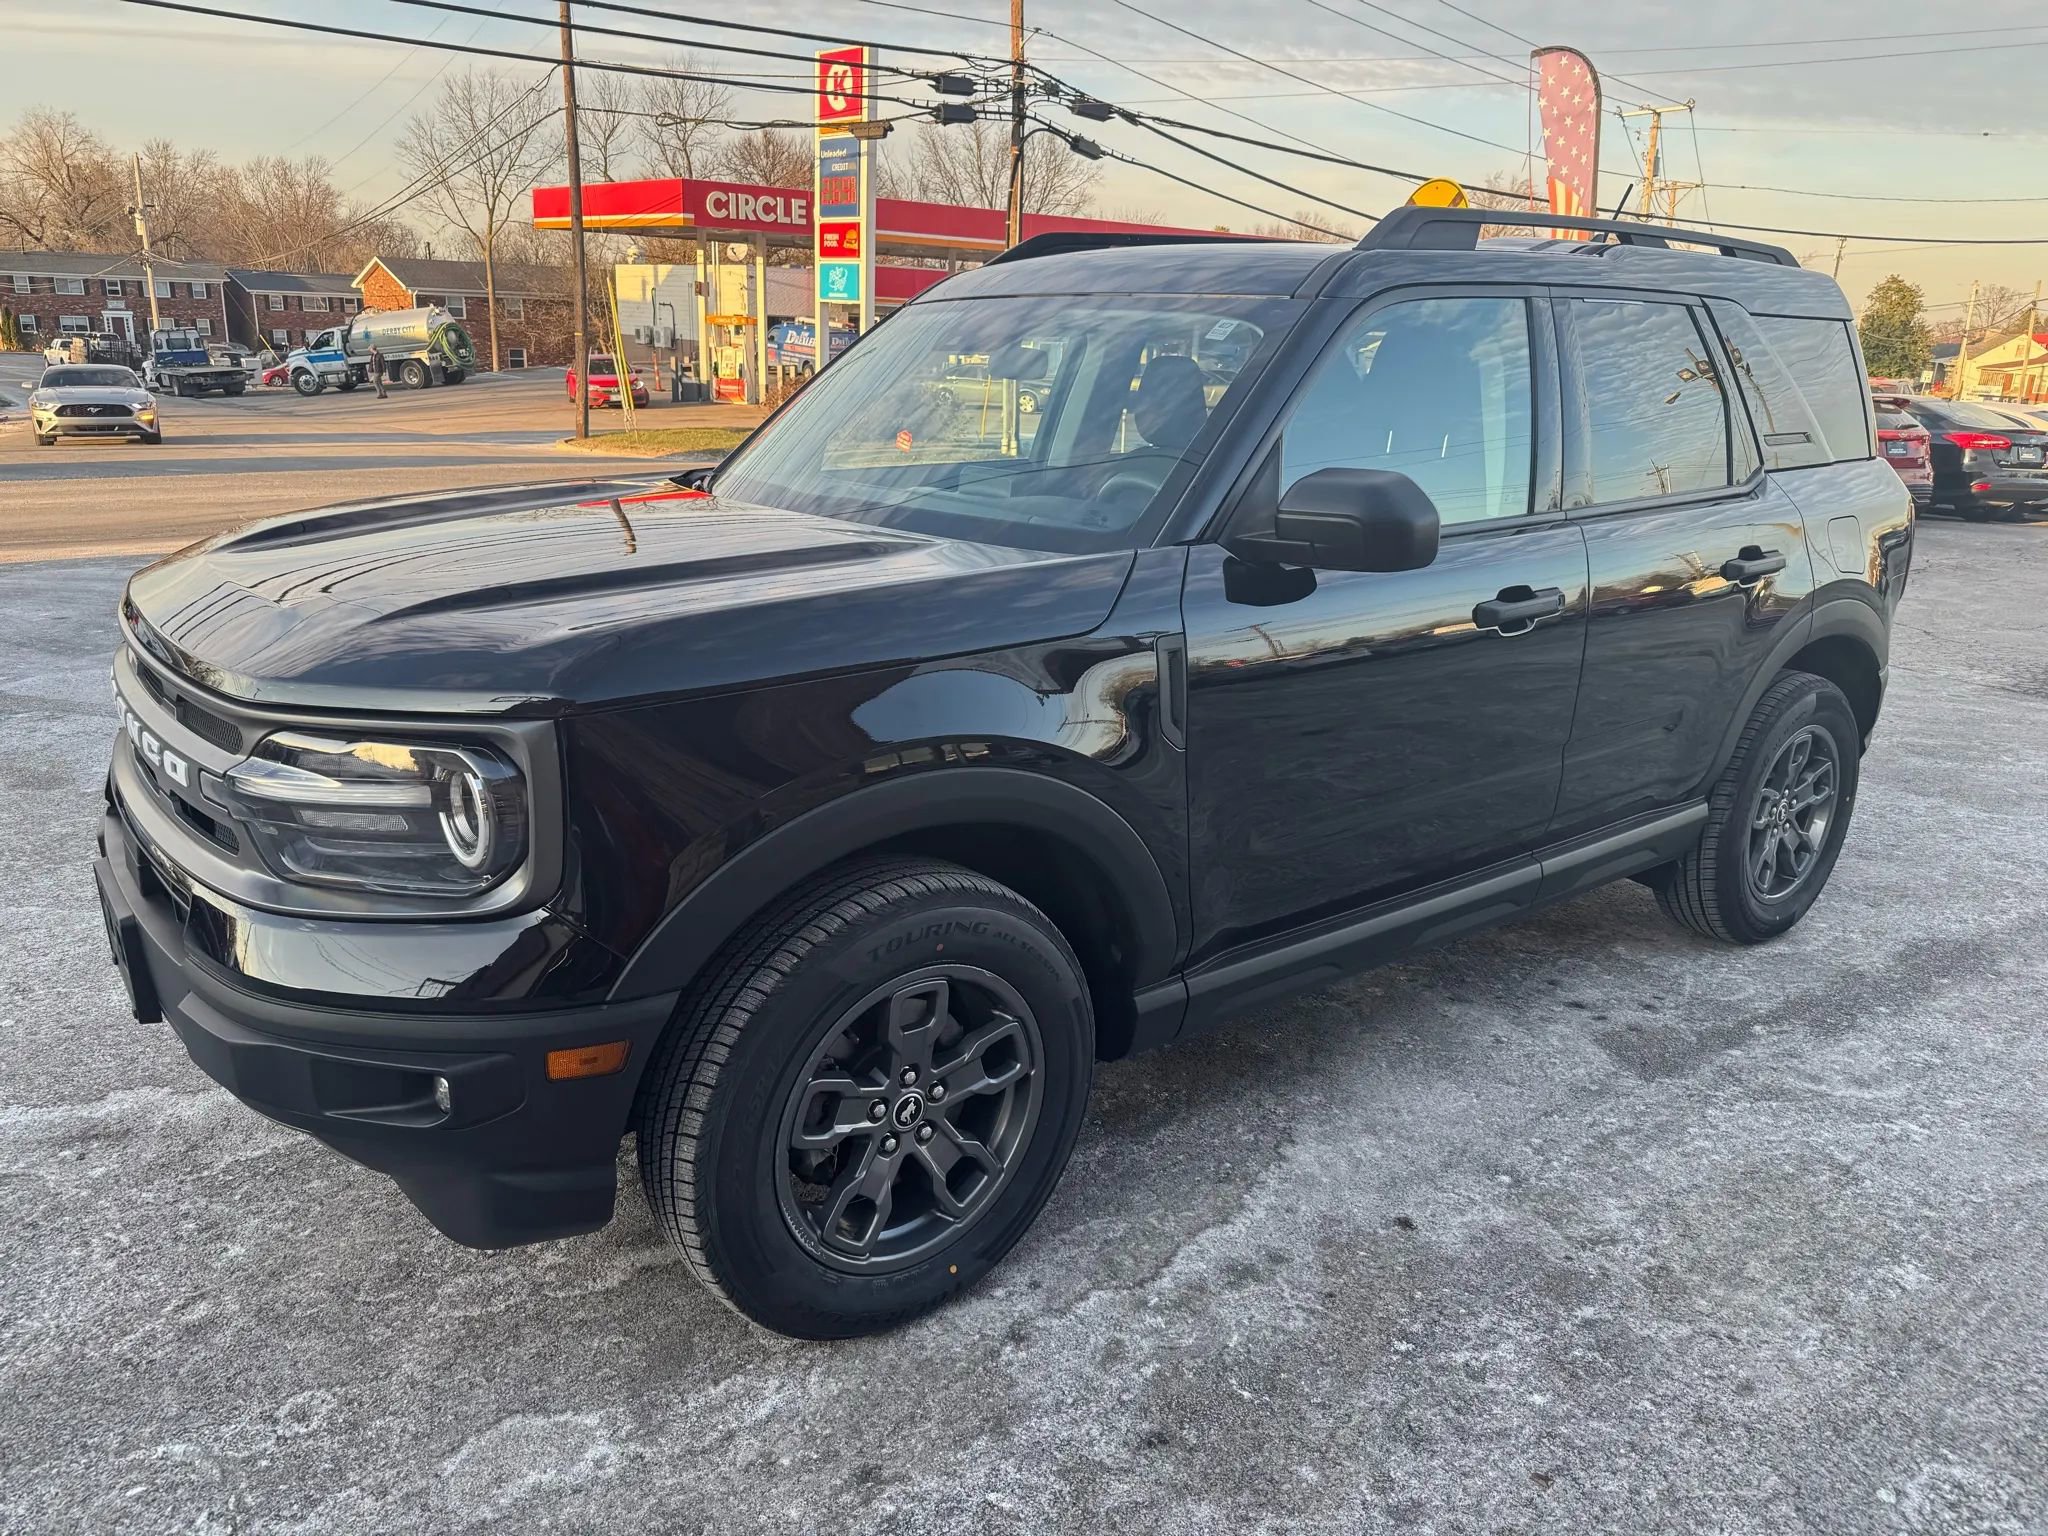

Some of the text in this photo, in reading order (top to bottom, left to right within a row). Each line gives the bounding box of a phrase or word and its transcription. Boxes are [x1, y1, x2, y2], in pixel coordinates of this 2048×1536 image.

[821, 148, 847, 159] Unleaded
[706, 190, 807, 225] CIRCLE
[382, 325, 416, 336] DERBY CITY
[867, 920, 990, 962] TOURING
